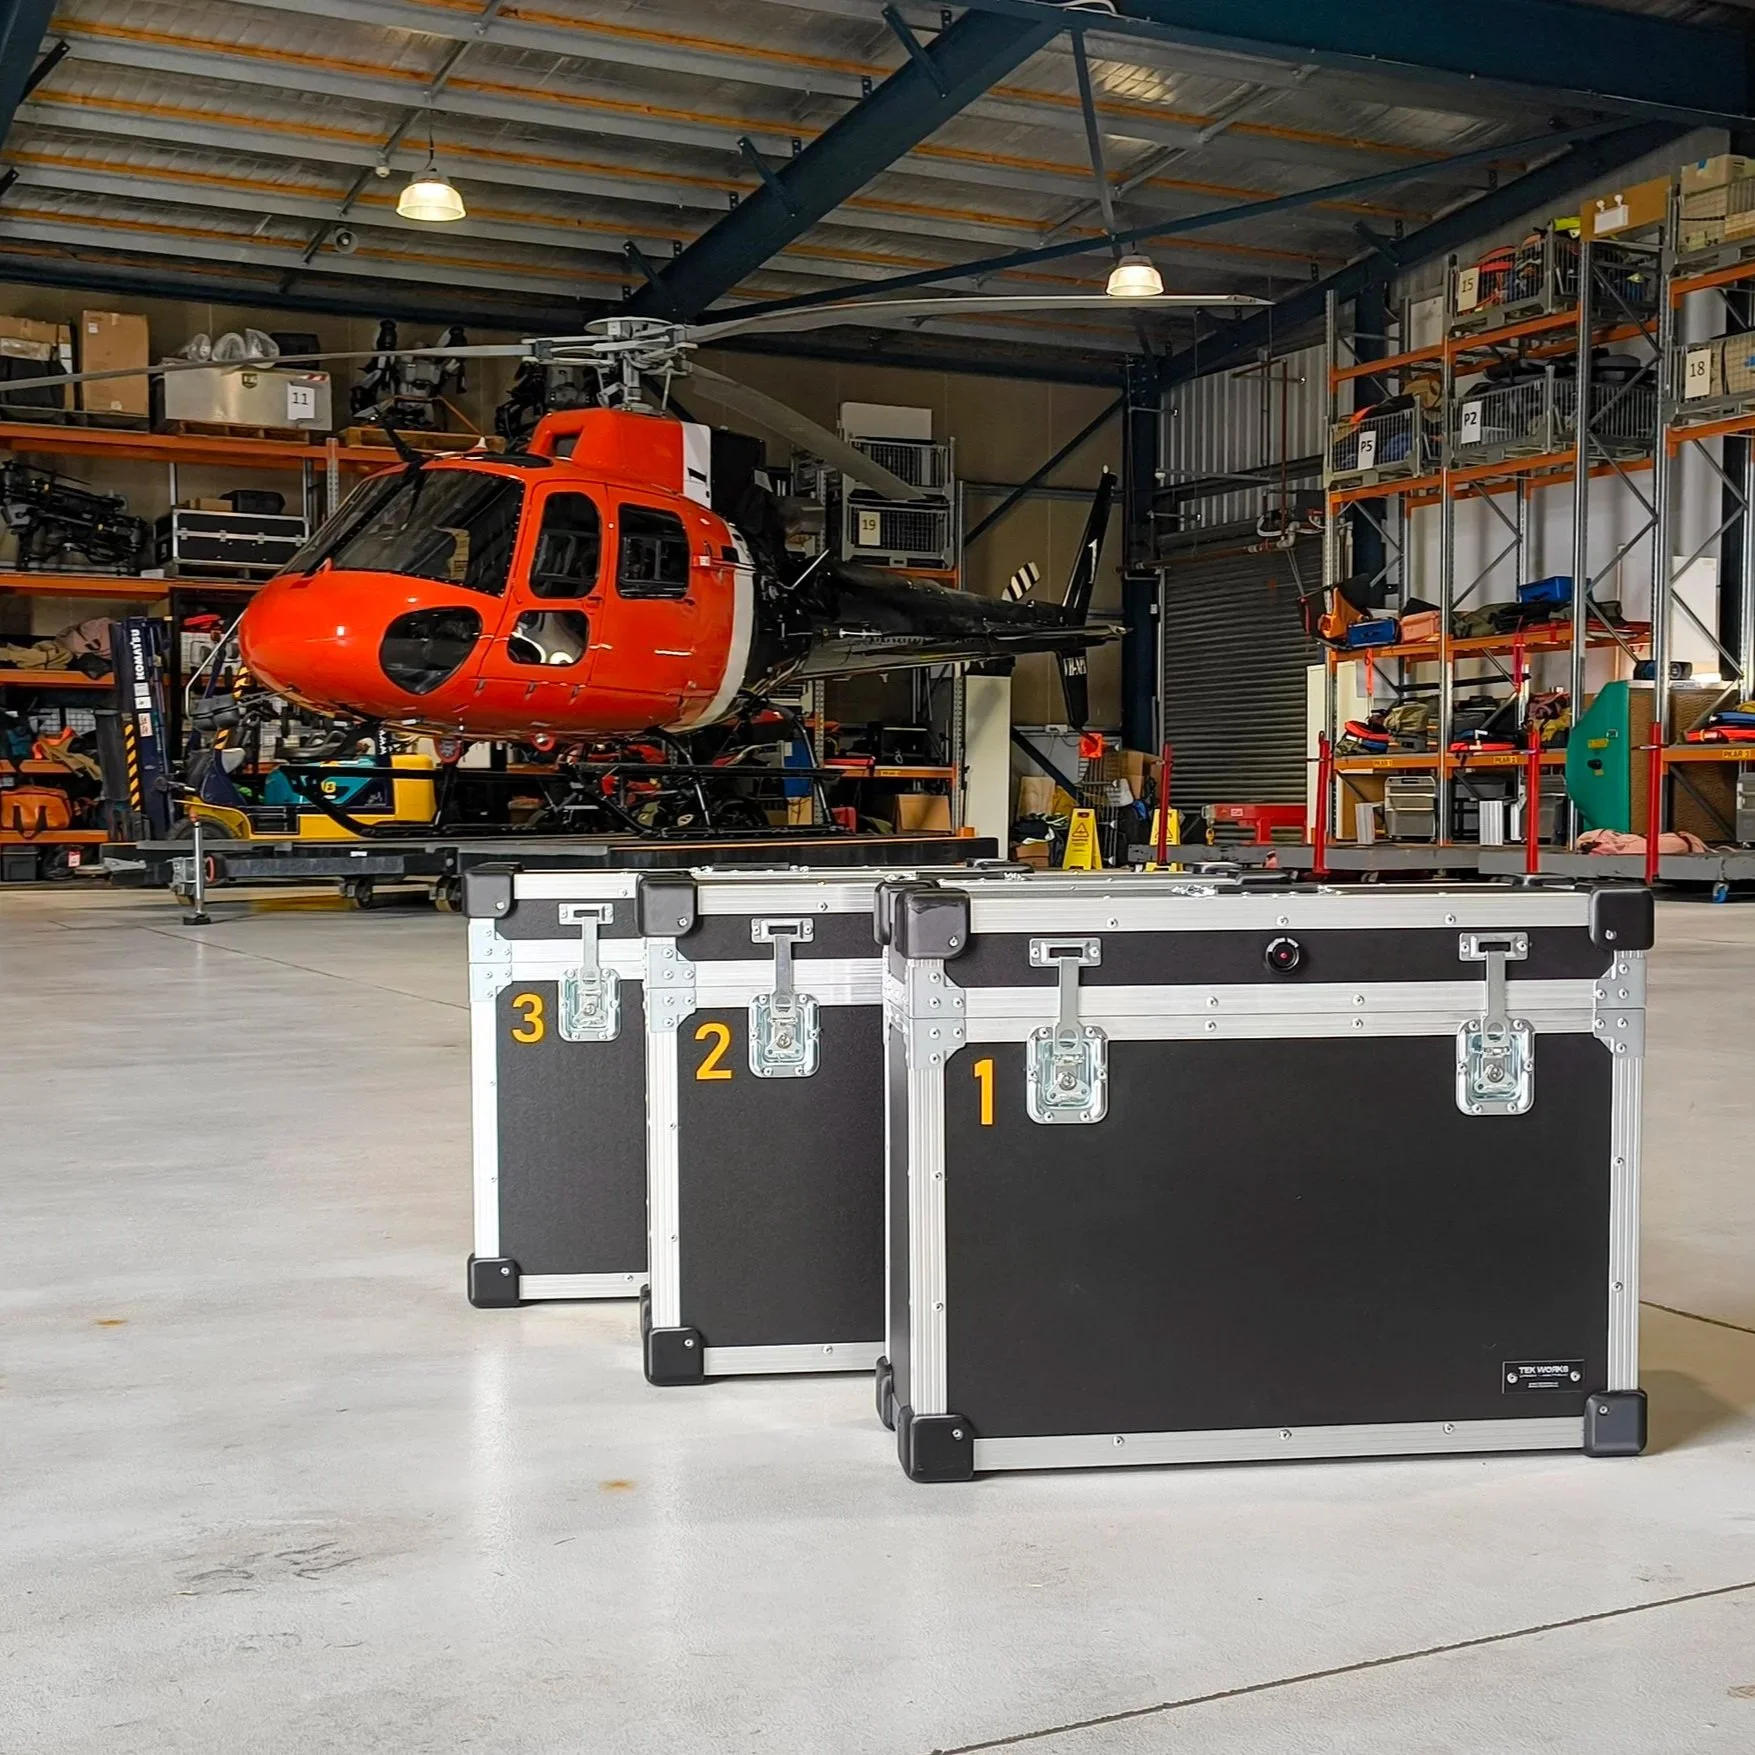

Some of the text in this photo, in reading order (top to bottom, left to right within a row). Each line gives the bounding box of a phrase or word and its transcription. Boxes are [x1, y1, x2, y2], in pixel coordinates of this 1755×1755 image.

[1462, 277, 1474, 293] 15
[1690, 361, 1705, 377] 18
[292, 392, 308, 405] 11
[1464, 411, 1477, 426] P2
[1361, 440, 1373, 452] P5
[863, 519, 876, 530] 19
[130, 628, 146, 680] KOMATSU
[511, 993, 546, 1042] 3
[695, 1023, 733, 1080] 2
[974, 1058, 994, 1125] 1
[1518, 1365, 1569, 1374] TEK WORKS
